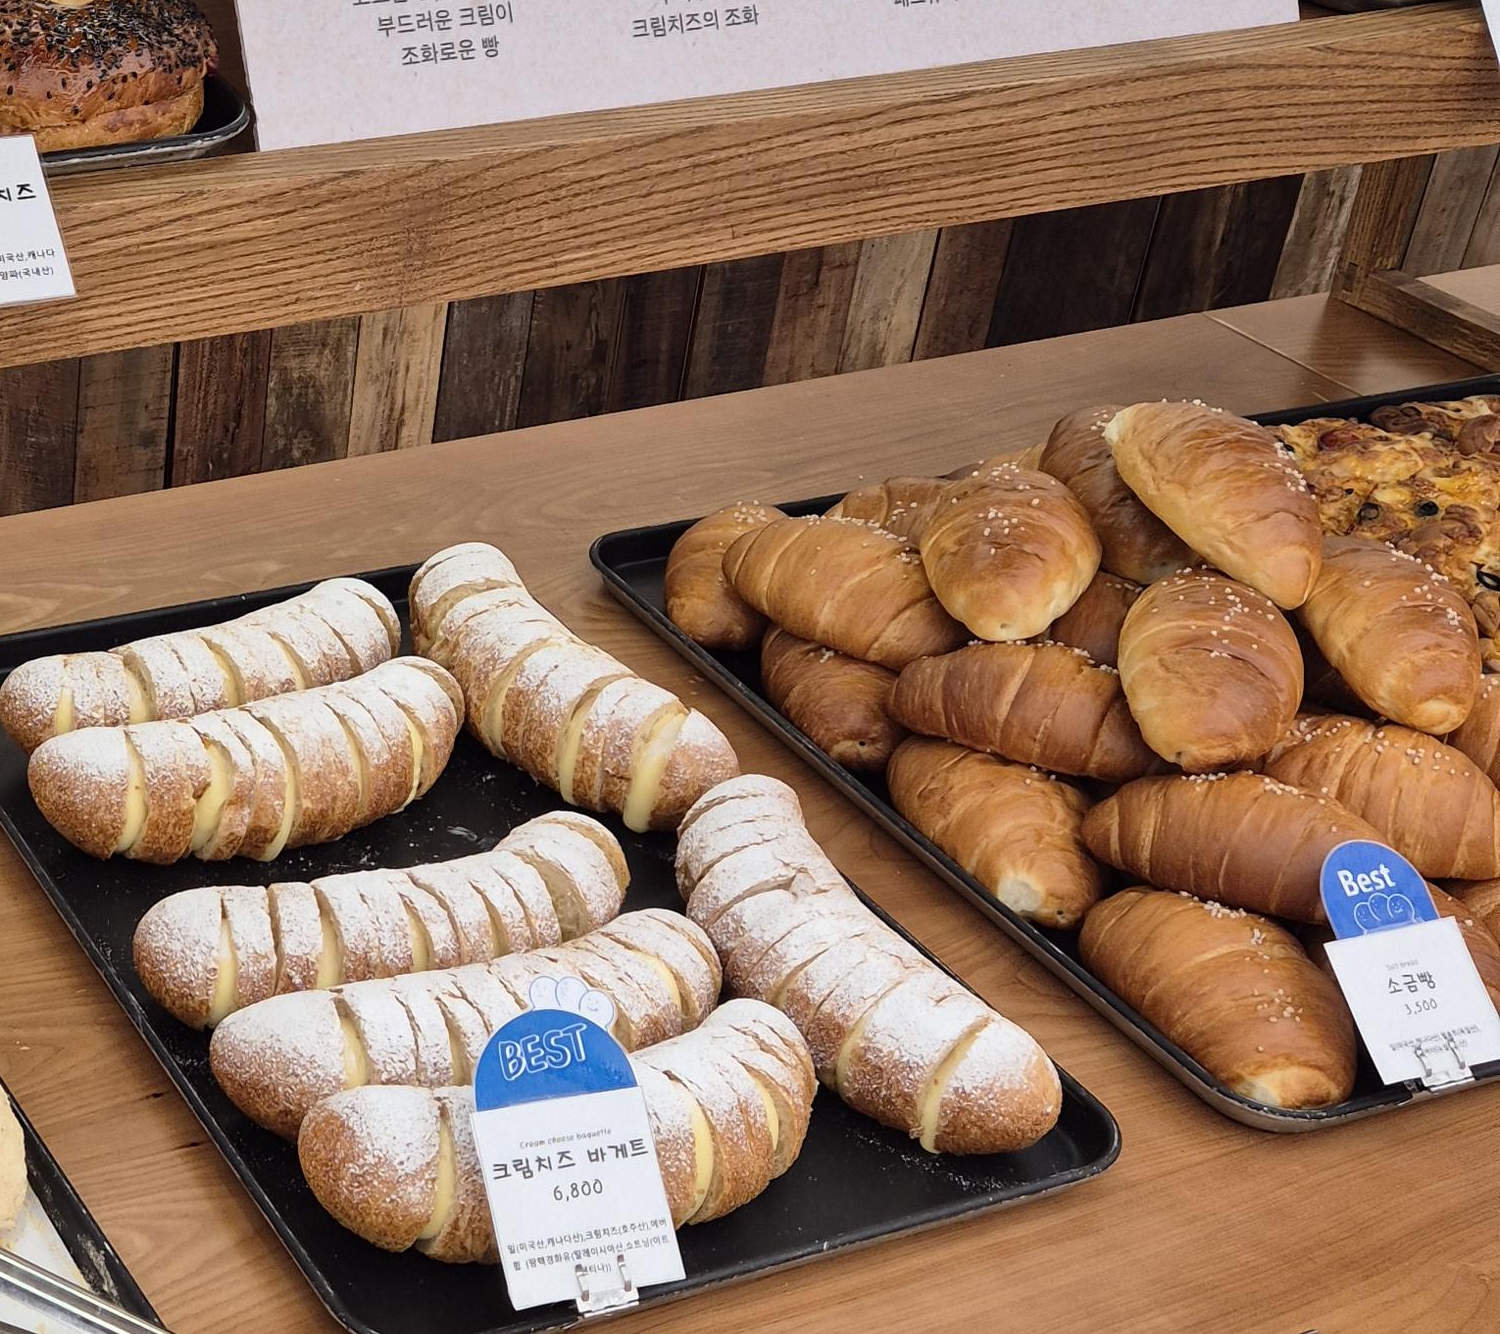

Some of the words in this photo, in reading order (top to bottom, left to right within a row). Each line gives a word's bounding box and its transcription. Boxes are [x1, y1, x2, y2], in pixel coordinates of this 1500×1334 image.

[377, 8, 453, 37] 부드러운
[459, 1, 515, 27] 크림이
[631, 10, 720, 38] 크림치즈의
[724, 4, 760, 28] 조화
[401, 40, 477, 66] 조화로운
[481, 35, 500, 58] 빵
[1337, 863, 1396, 898] Best
[1388, 971, 1436, 994] 소금빵
[499, 1023, 587, 1082] BEST
[492, 1151, 576, 1180] 크림치즈
[586, 1138, 649, 1164] 바게트
[553, 1178, 603, 1203] 6,800
